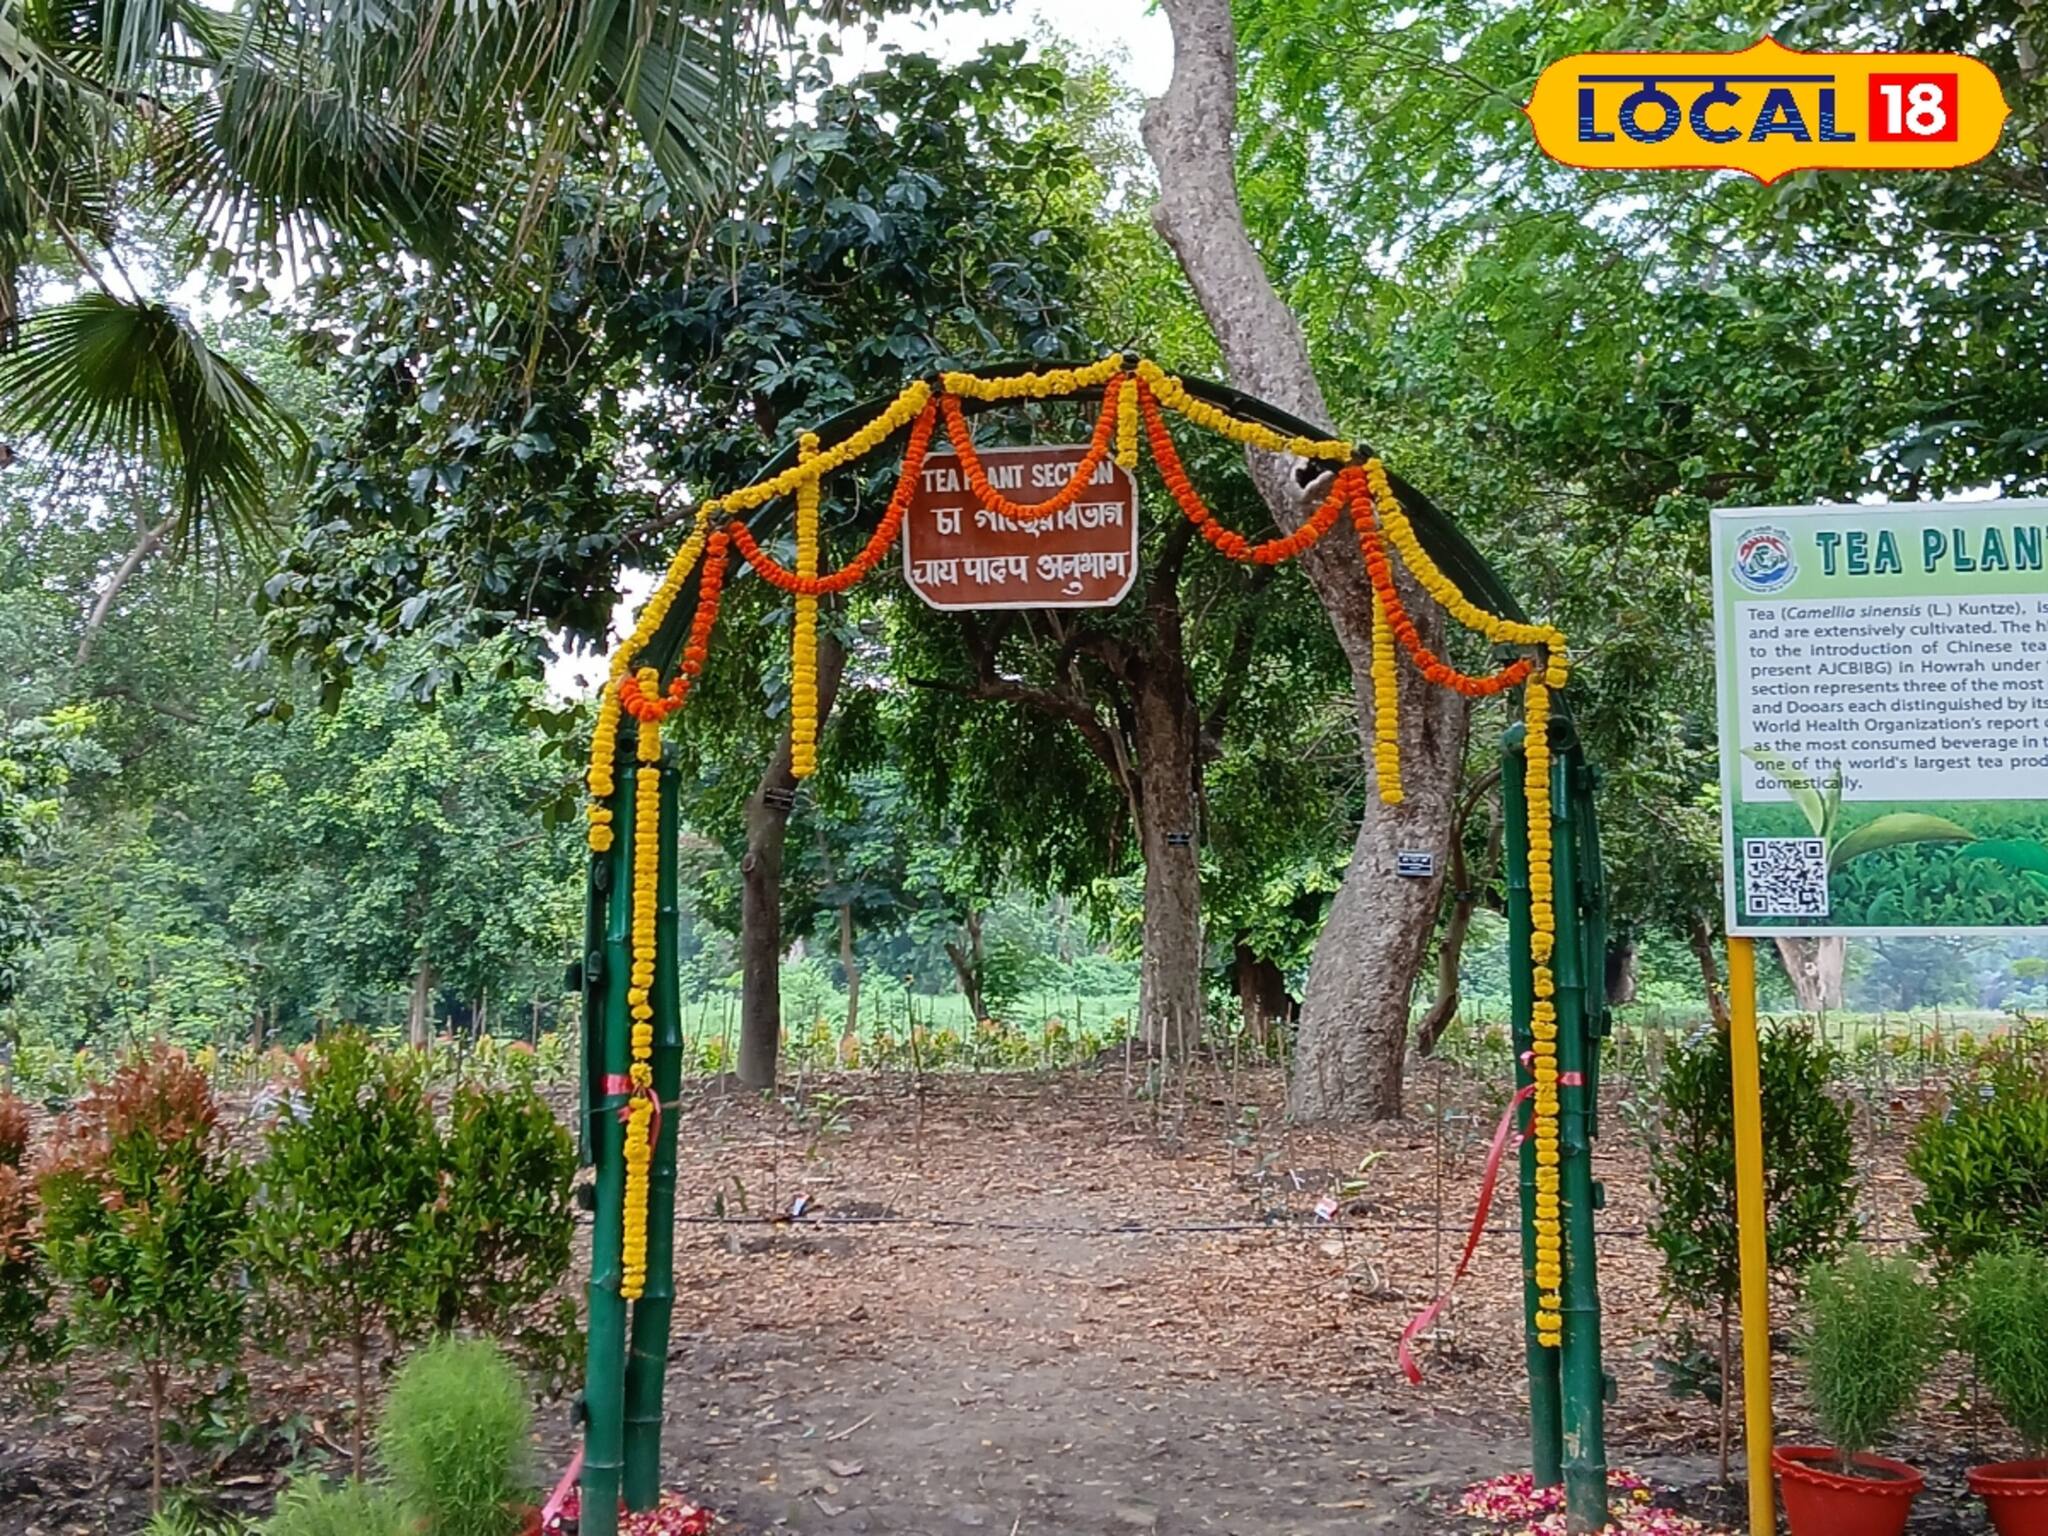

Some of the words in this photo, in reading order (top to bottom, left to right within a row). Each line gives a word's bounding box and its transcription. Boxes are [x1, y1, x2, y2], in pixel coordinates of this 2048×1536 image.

[921, 469, 959, 492] TEA
[930, 507, 963, 535] চা
[1816, 530, 1902, 575] TEA
[912, 559, 960, 587] चाय
[962, 556, 1030, 584] पादप
[1036, 552, 1130, 595] अनुभाग
[1748, 608, 1774, 620] Tea
[1860, 605, 1921, 617] sinensis
[1748, 626, 1779, 639] and
[1784, 628, 1810, 638] are
[1814, 623, 1905, 639] extensively
[1910, 621, 1997, 635] cultivated.
[2000, 620, 2031, 634] The
[1750, 646, 1767, 658] to
[1775, 645, 1802, 658] the
[1810, 643, 1912, 656] introduction
[1922, 641, 1938, 654] of
[1947, 640, 2013, 654] Chinese
[2020, 642, 2047, 652] tea
[1750, 664, 1811, 678] present
[1818, 661, 1892, 675] AJCBIBG)
[1899, 661, 1914, 673] in
[1921, 658, 1985, 673] Howrah
[1992, 658, 2041, 672] under
[1752, 682, 1809, 695] section
[1814, 681, 1899, 696] represents
[1904, 679, 1947, 692] three
[1951, 677, 1969, 691] of
[1971, 678, 1999, 691] the
[2002, 678, 2044, 691] most
[1752, 701, 1783, 714] and
[1787, 700, 1844, 714] Dooars
[1848, 699, 1887, 713] each
[1890, 697, 2002, 714] distinguished
[2007, 697, 2027, 713] by
[1752, 720, 1801, 733] World
[1806, 719, 1859, 732] Health
[1987, 717, 2040, 732] report
[1753, 741, 1770, 752] as
[1775, 738, 1802, 751] the
[1806, 739, 1847, 751] most
[1851, 737, 1936, 750] consumed
[1941, 736, 2019, 752] beverage
[2023, 735, 2038, 748] in
[1754, 760, 1786, 771] one
[1791, 757, 1809, 770] of
[1815, 757, 1842, 770] the
[1848, 756, 1908, 769] world's
[1914, 756, 1971, 772] largest
[1978, 757, 2003, 769] tea
[1755, 776, 1863, 791] domestically.
